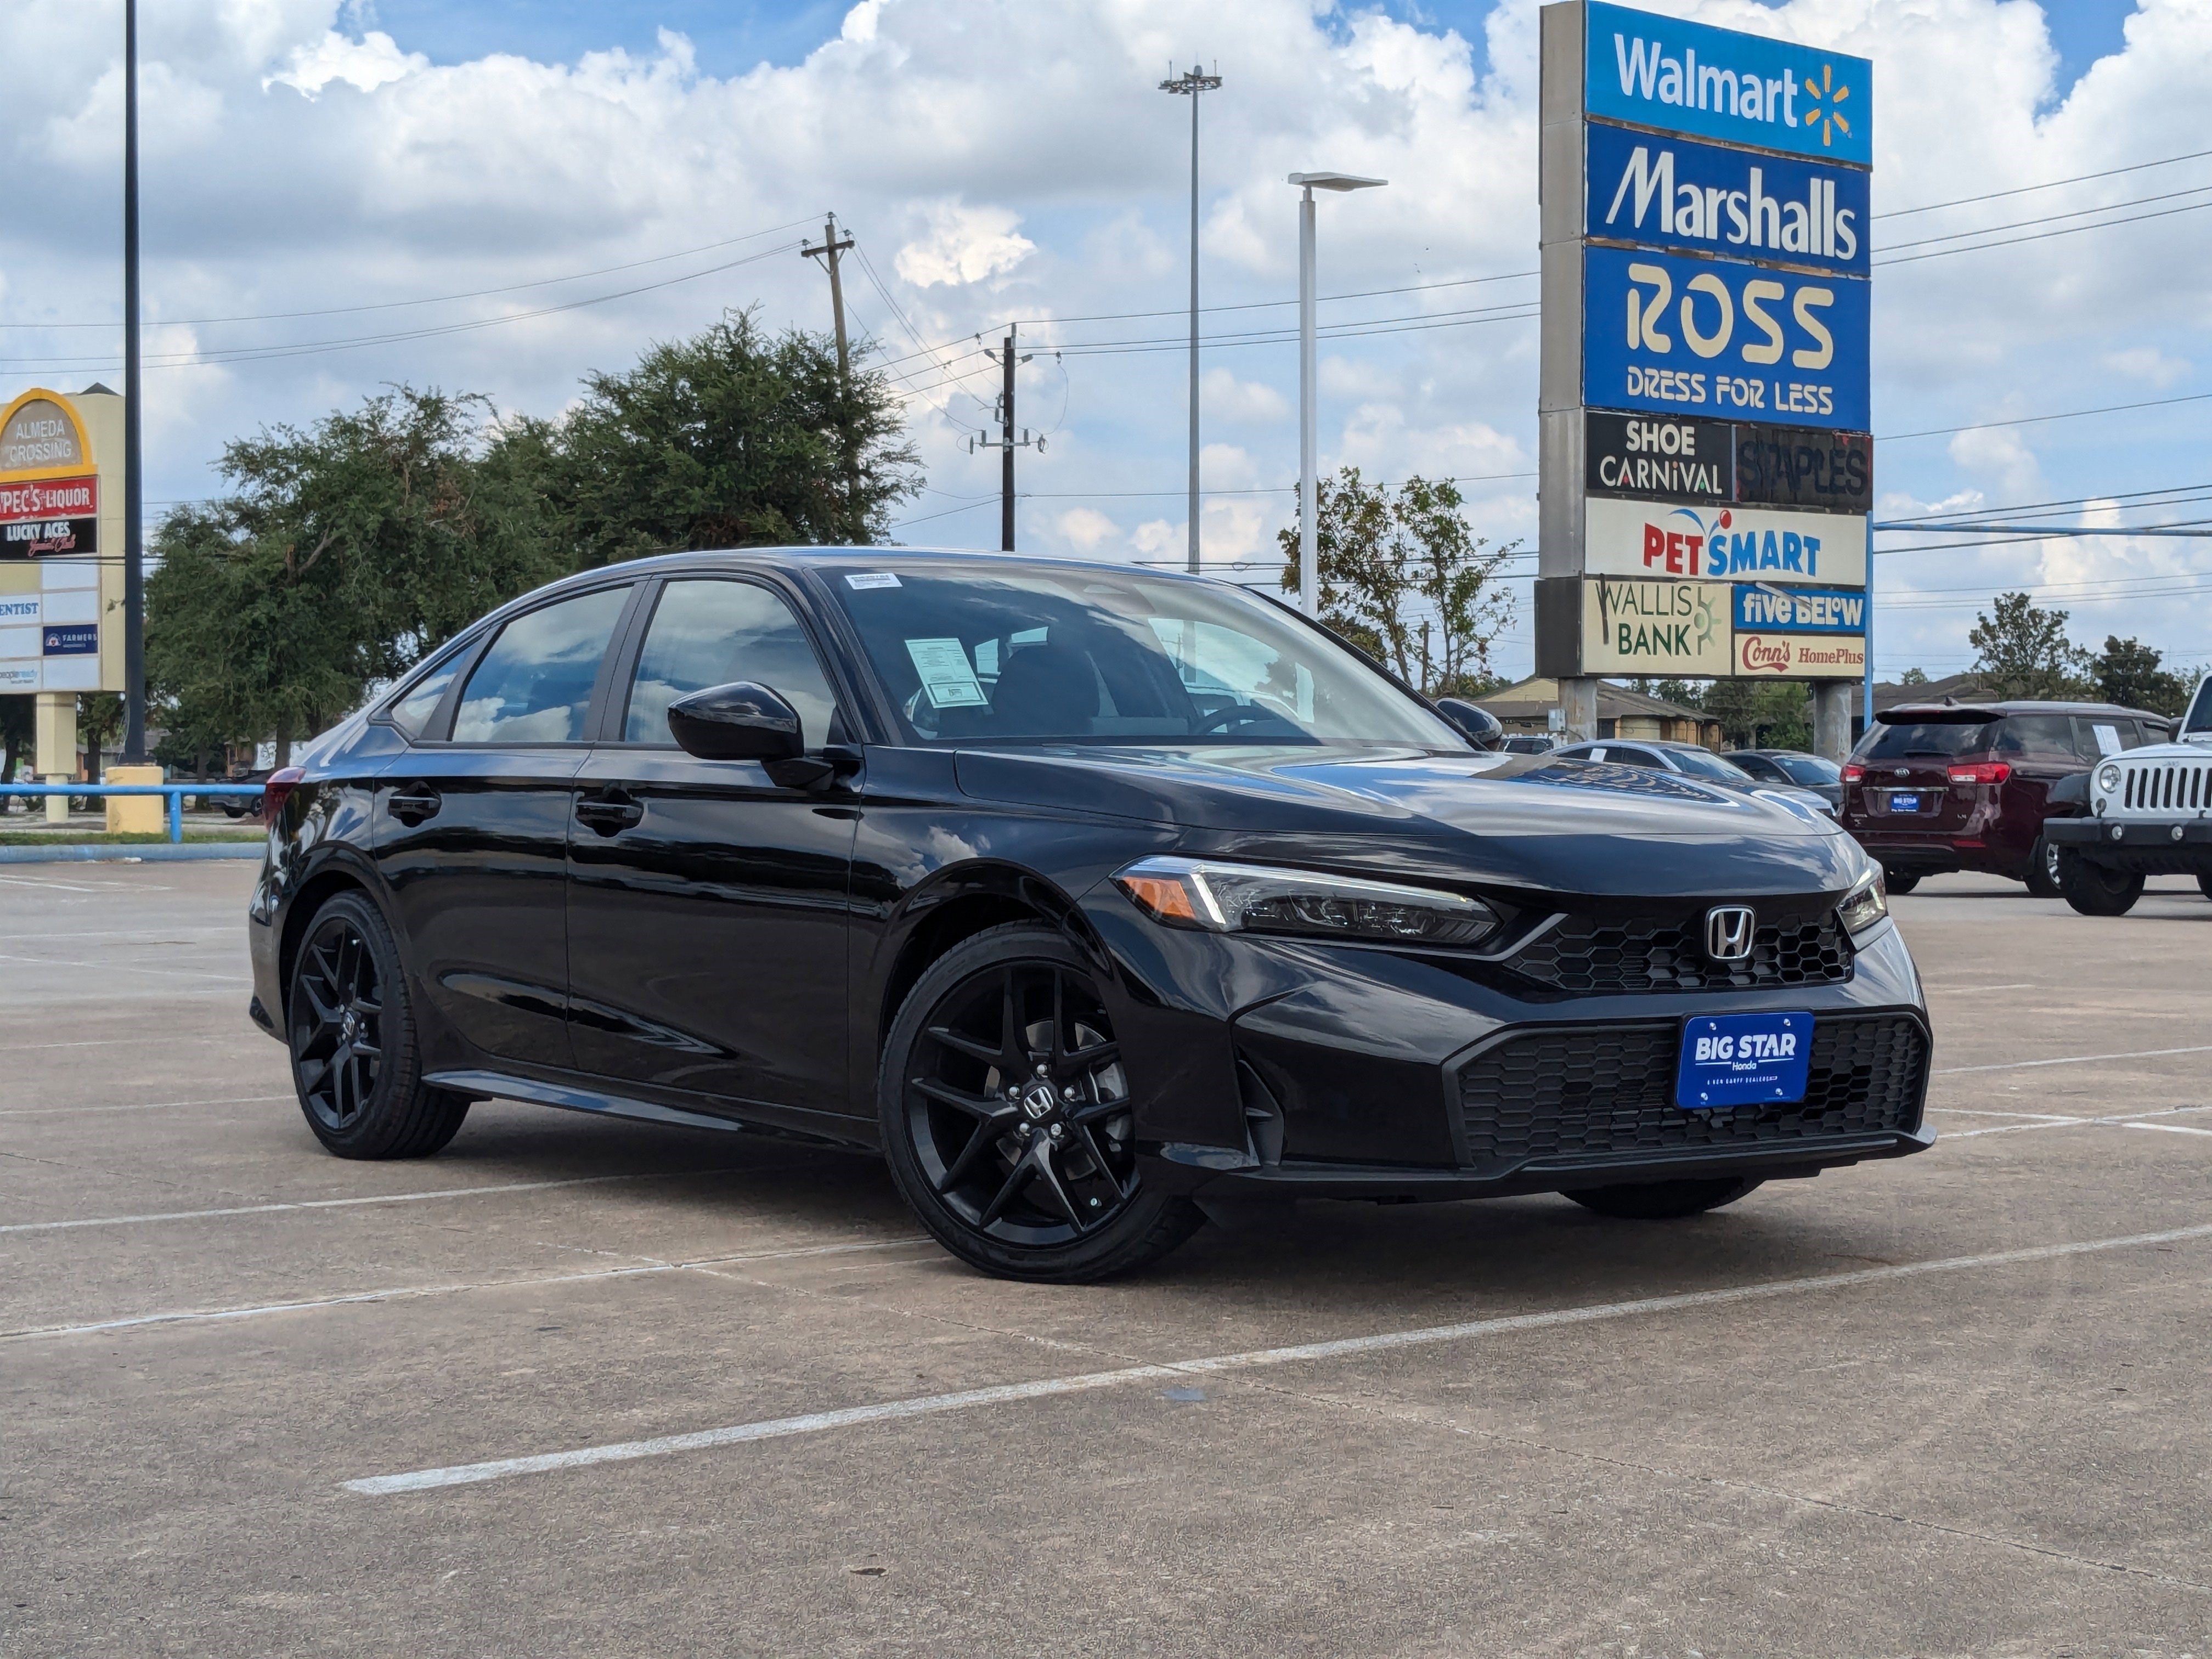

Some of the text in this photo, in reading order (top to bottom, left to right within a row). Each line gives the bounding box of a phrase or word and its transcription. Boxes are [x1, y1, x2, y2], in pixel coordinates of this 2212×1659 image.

[1613, 33, 1798, 128] Walmart
[1605, 146, 1857, 260] Marshalls
[1627, 263, 1834, 370] ROSS
[1627, 366, 1833, 415] DRESS FOR LESS
[16, 419, 65, 439] ALMEDA
[1626, 420, 1695, 456] SHOE
[9, 441, 72, 462] CROSSING
[1738, 441, 1868, 496] STAPLES
[0, 484, 91, 514] PEC'S LIQUOR
[7, 521, 71, 541] LUCKY ACES
[1595, 582, 1692, 617] WALLIS
[1743, 592, 1792, 624] five
[63, 633, 97, 642] FARMERS
[1618, 622, 1692, 657] BANK
[1742, 636, 1864, 673] Conn's HomePlus
[1695, 1033, 1796, 1060] BIG STAR
[1732, 1060, 1757, 1071] Honda
